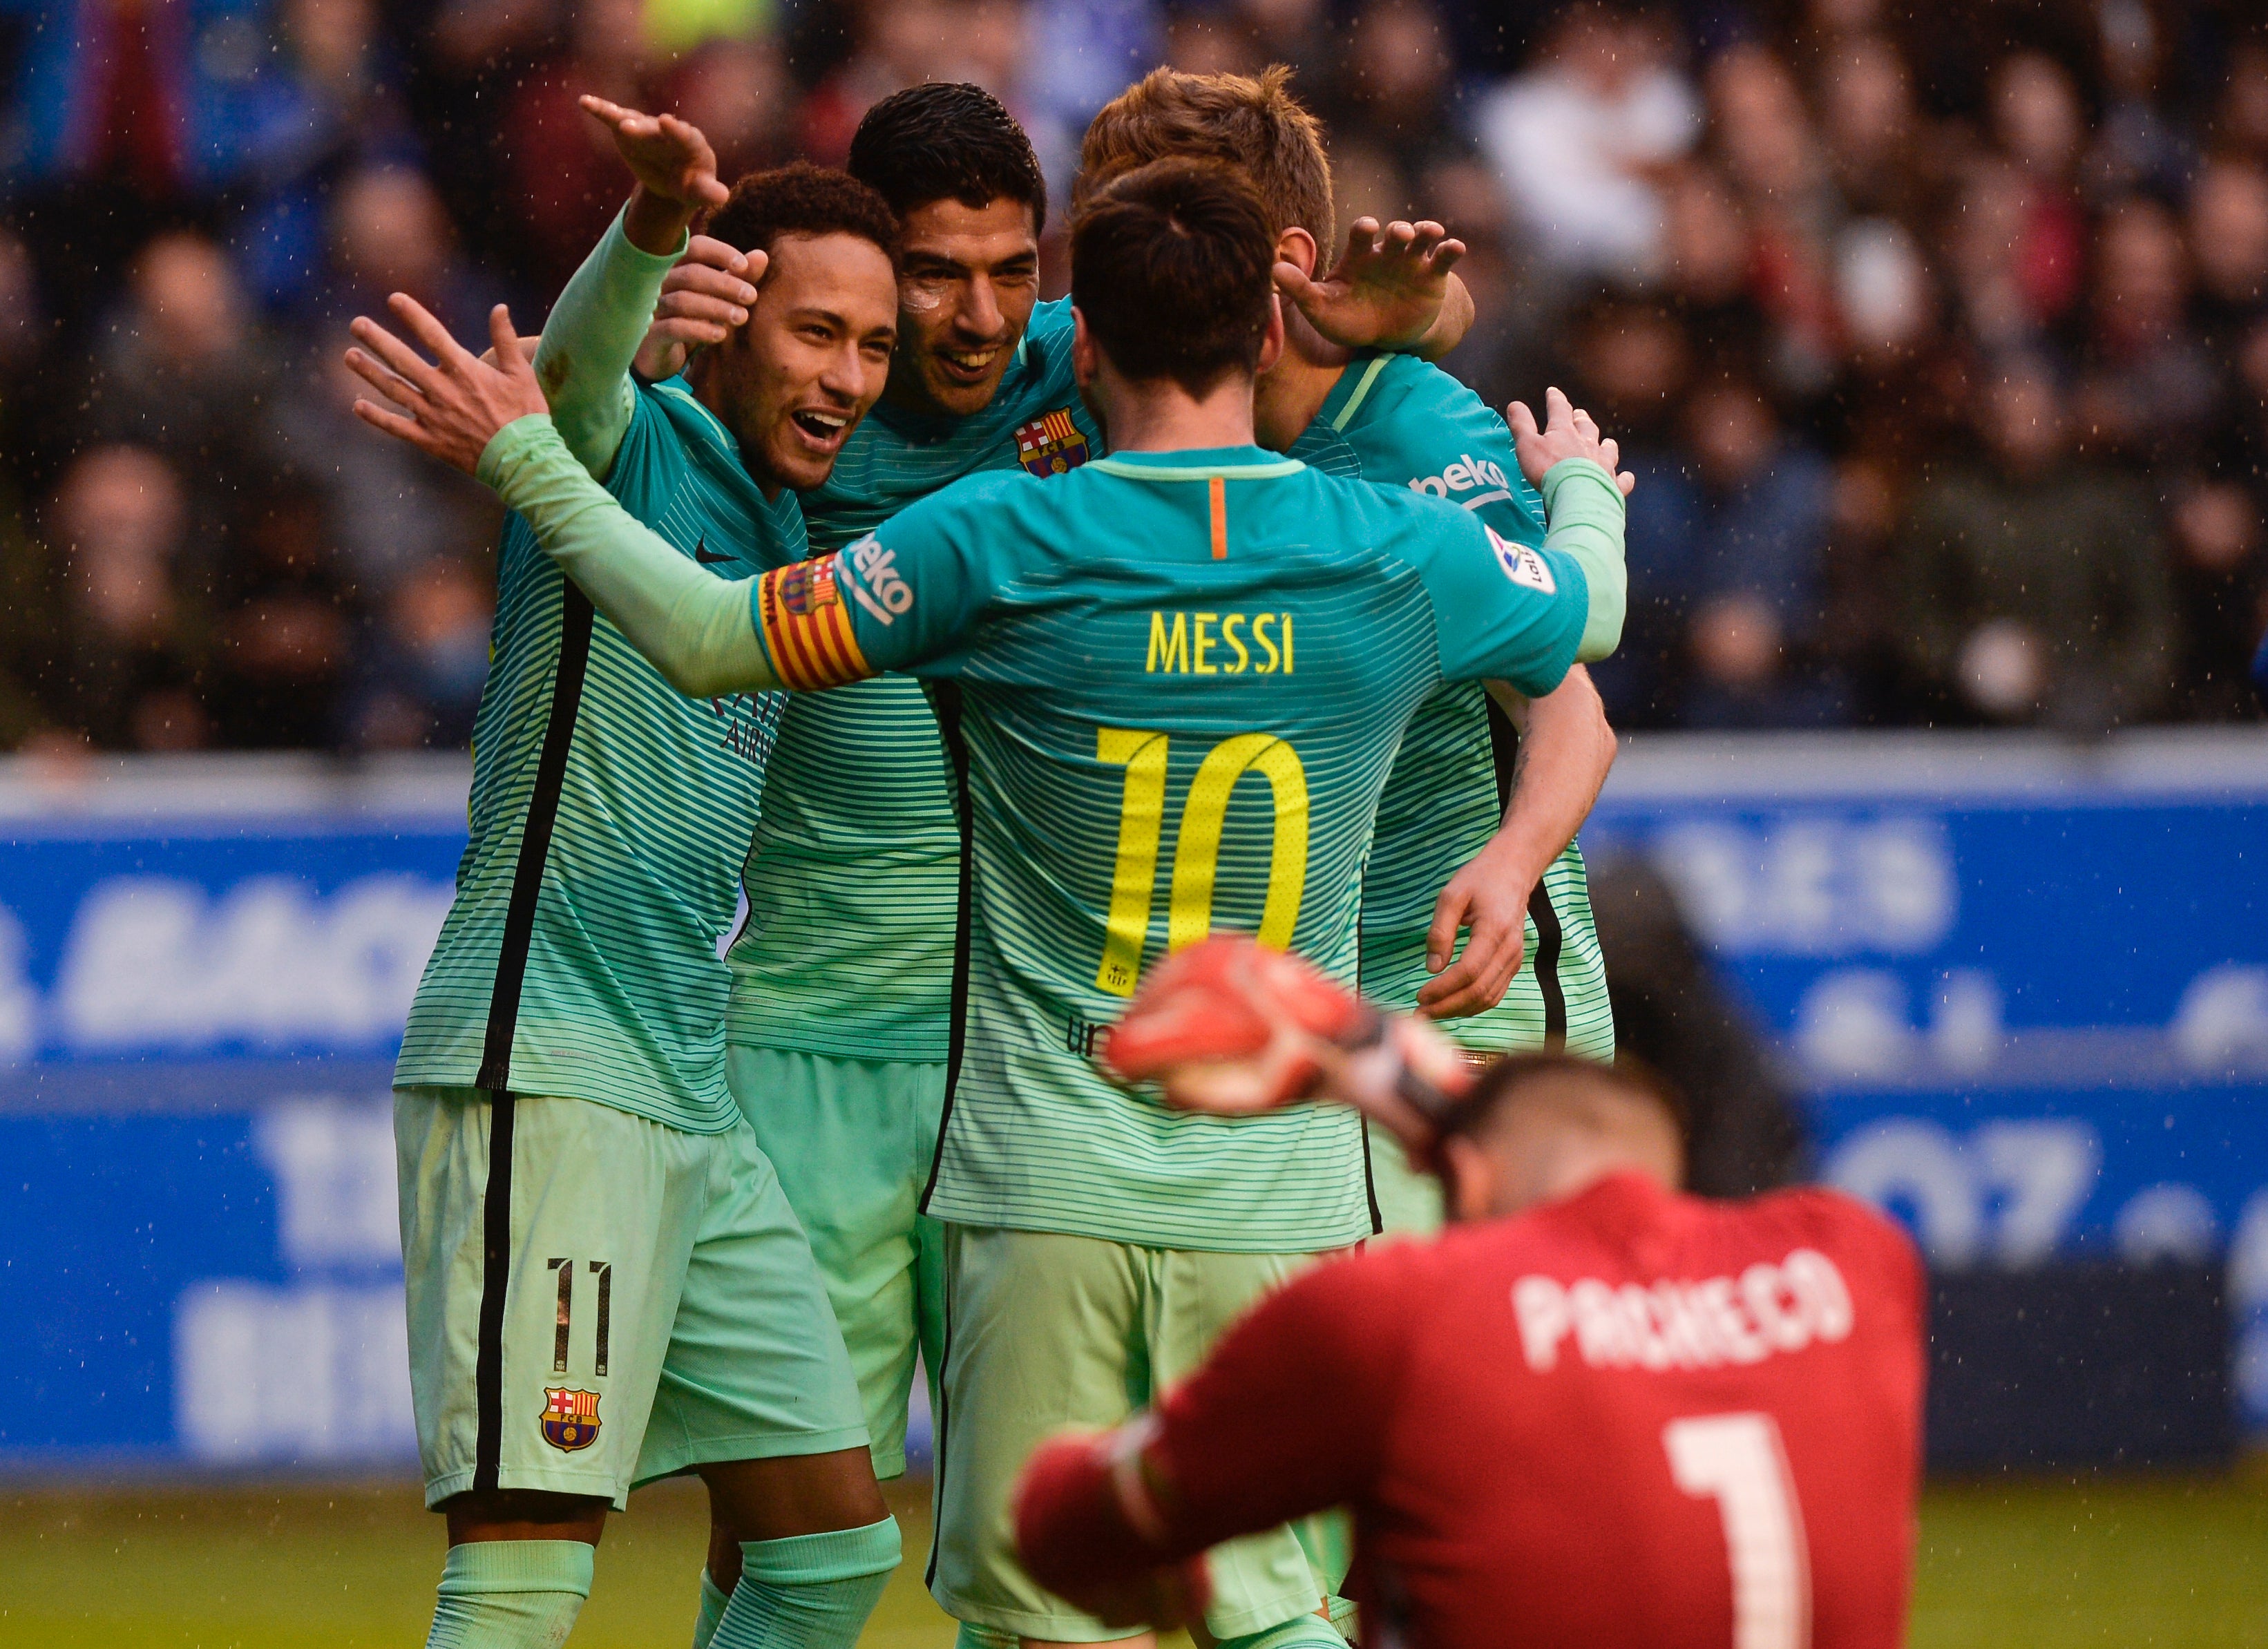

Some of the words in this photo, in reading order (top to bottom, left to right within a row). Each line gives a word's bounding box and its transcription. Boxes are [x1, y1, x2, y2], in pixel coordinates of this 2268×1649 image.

[1146, 611, 1294, 674] MESSI
[1096, 728, 1309, 997] 10
[547, 1258, 611, 1377] 11
[560, 1414, 582, 1423] FCB
[1664, 1409, 1813, 1649] 1
